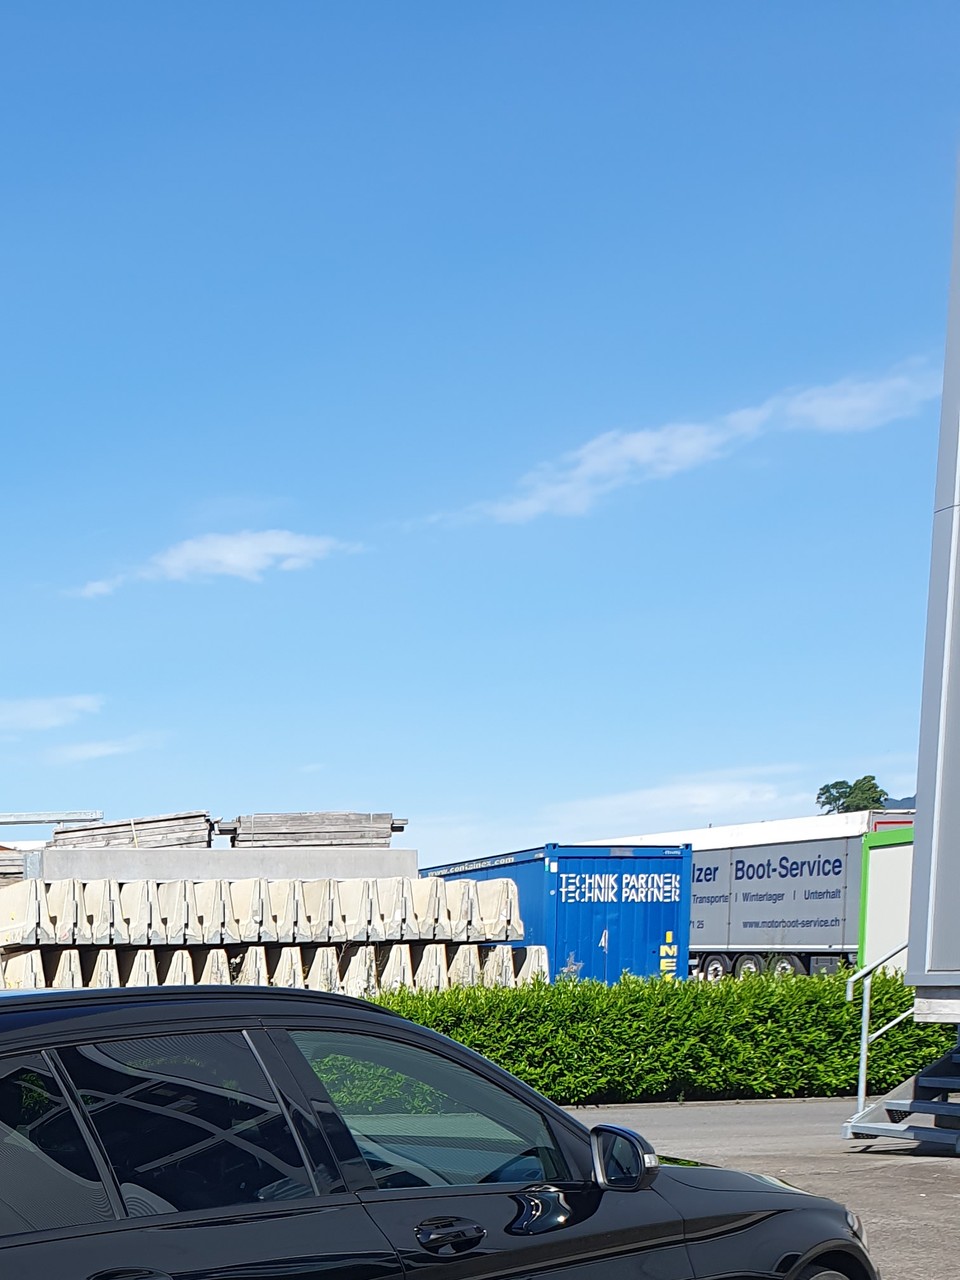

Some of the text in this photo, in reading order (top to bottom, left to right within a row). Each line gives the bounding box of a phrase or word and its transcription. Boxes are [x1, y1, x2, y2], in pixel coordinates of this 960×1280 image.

[735, 854, 842, 880] Boot-Service
[559, 874, 680, 888] TECHNIK PARTNER
[559, 888, 680, 902] TECHNIK PARTNER
[692, 889, 841, 905] Transporte Winterlager Unterhalt
[696, 920, 705, 929] 25
[742, 917, 840, 928] www.motorboot-service.ch
